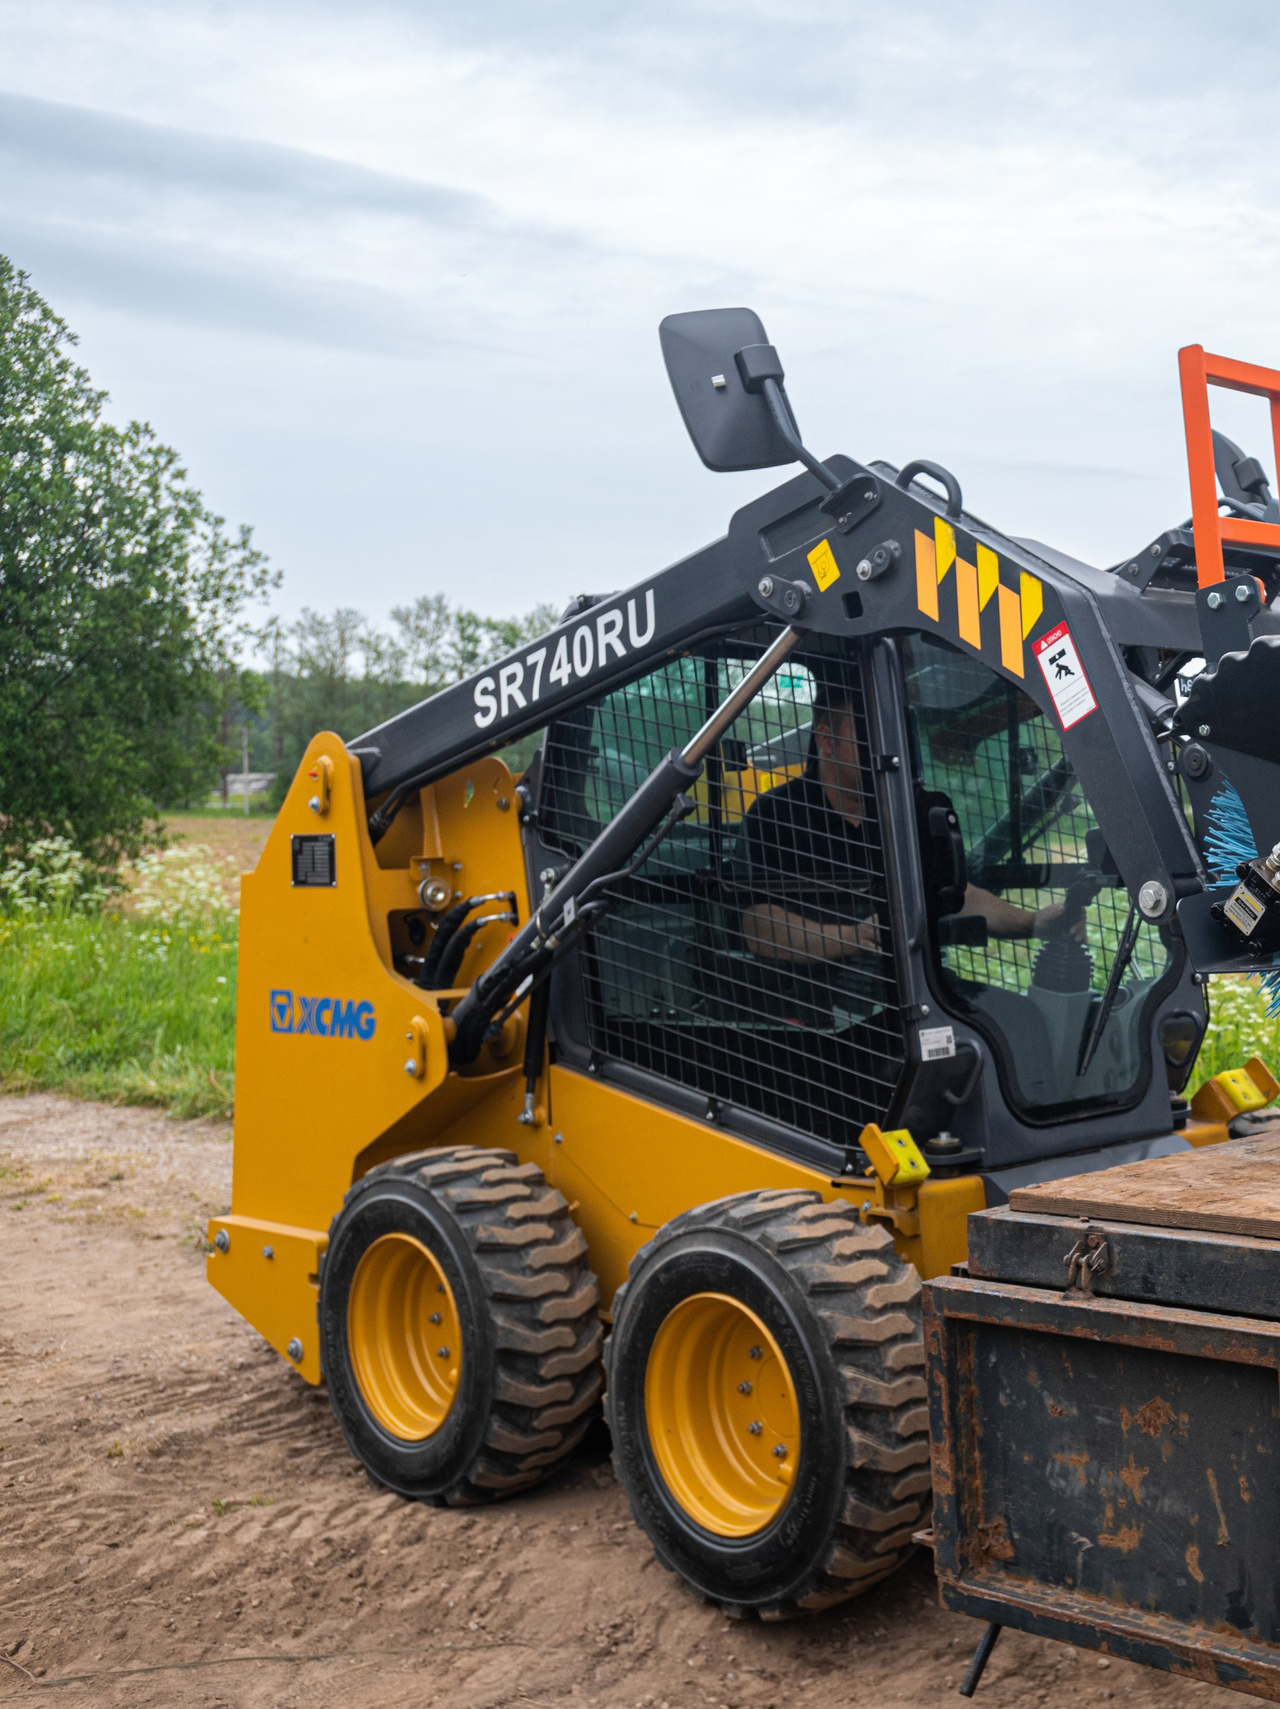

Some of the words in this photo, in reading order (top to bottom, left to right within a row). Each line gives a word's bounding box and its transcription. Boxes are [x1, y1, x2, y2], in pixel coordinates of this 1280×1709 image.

[473, 588, 656, 729] SR740RU
[1244, 906, 1255, 918] Motor
[294, 995, 377, 1042] XCMG
